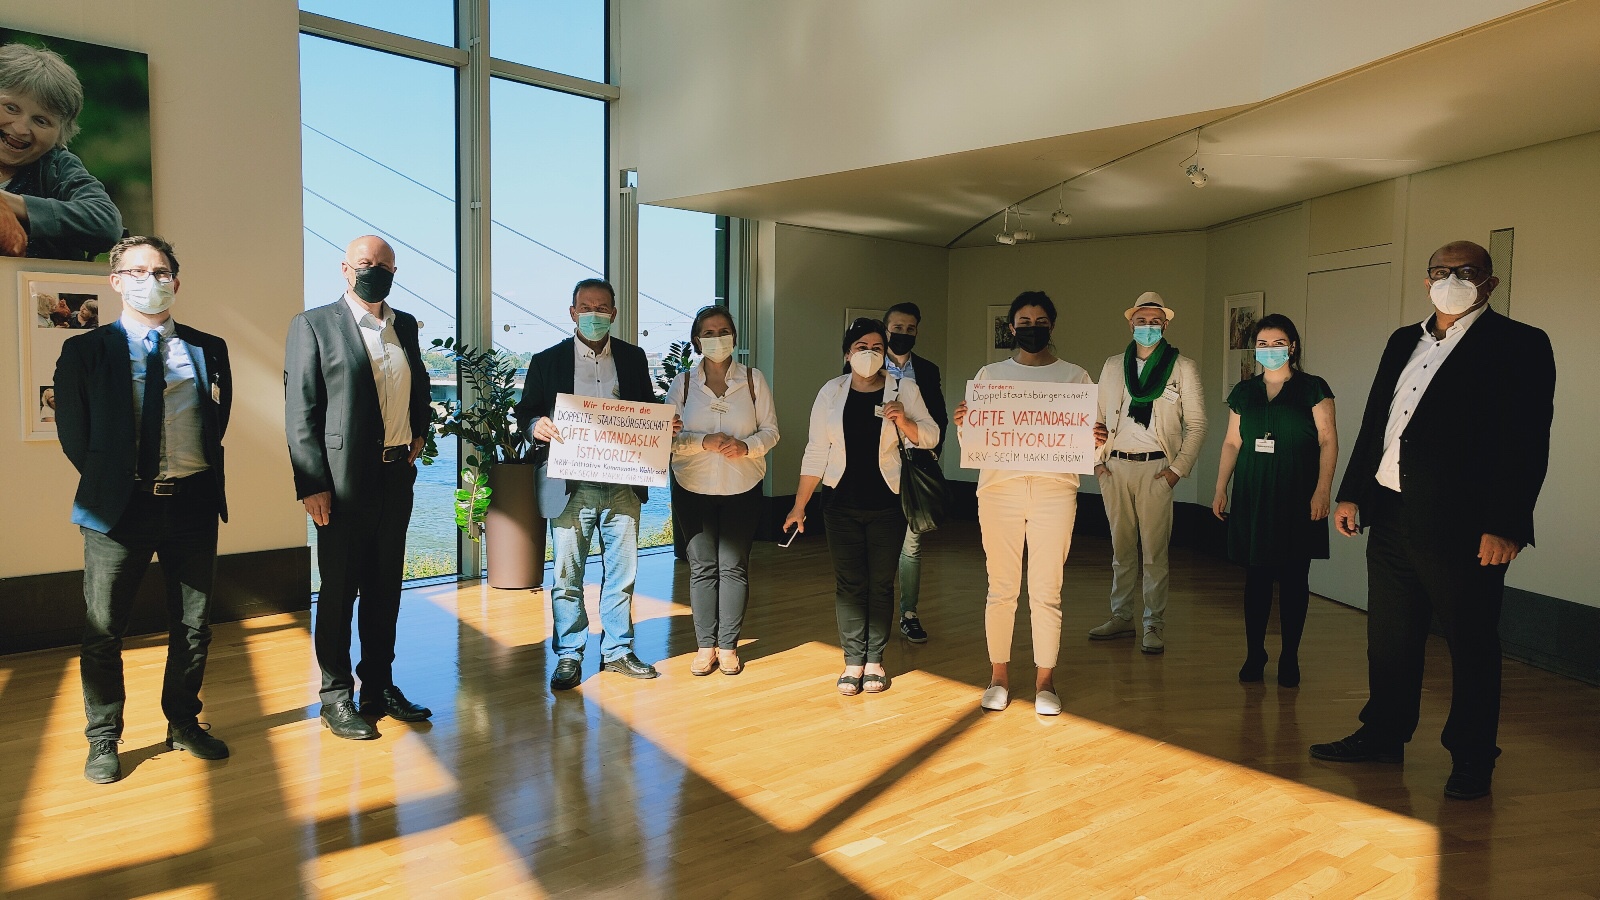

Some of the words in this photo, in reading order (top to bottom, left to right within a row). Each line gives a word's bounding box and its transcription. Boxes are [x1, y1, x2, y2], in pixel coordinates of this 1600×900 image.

[972, 389, 1088, 404] Doppelstaatsbürgerschaft
[583, 400, 598, 409] Wir
[602, 403, 635, 413] fordern
[639, 406, 652, 415] die
[557, 410, 594, 424] DOPPELTE
[597, 414, 670, 432] STAATSBÜRGERSCHAFT
[968, 408, 1005, 428] ÇİFTE
[1012, 410, 1090, 427] VATANDAŞLIK
[561, 425, 591, 442] ÇİFTE
[594, 429, 660, 448] VATANDAŞLIK
[1023, 453, 1049, 462] HAKKI
